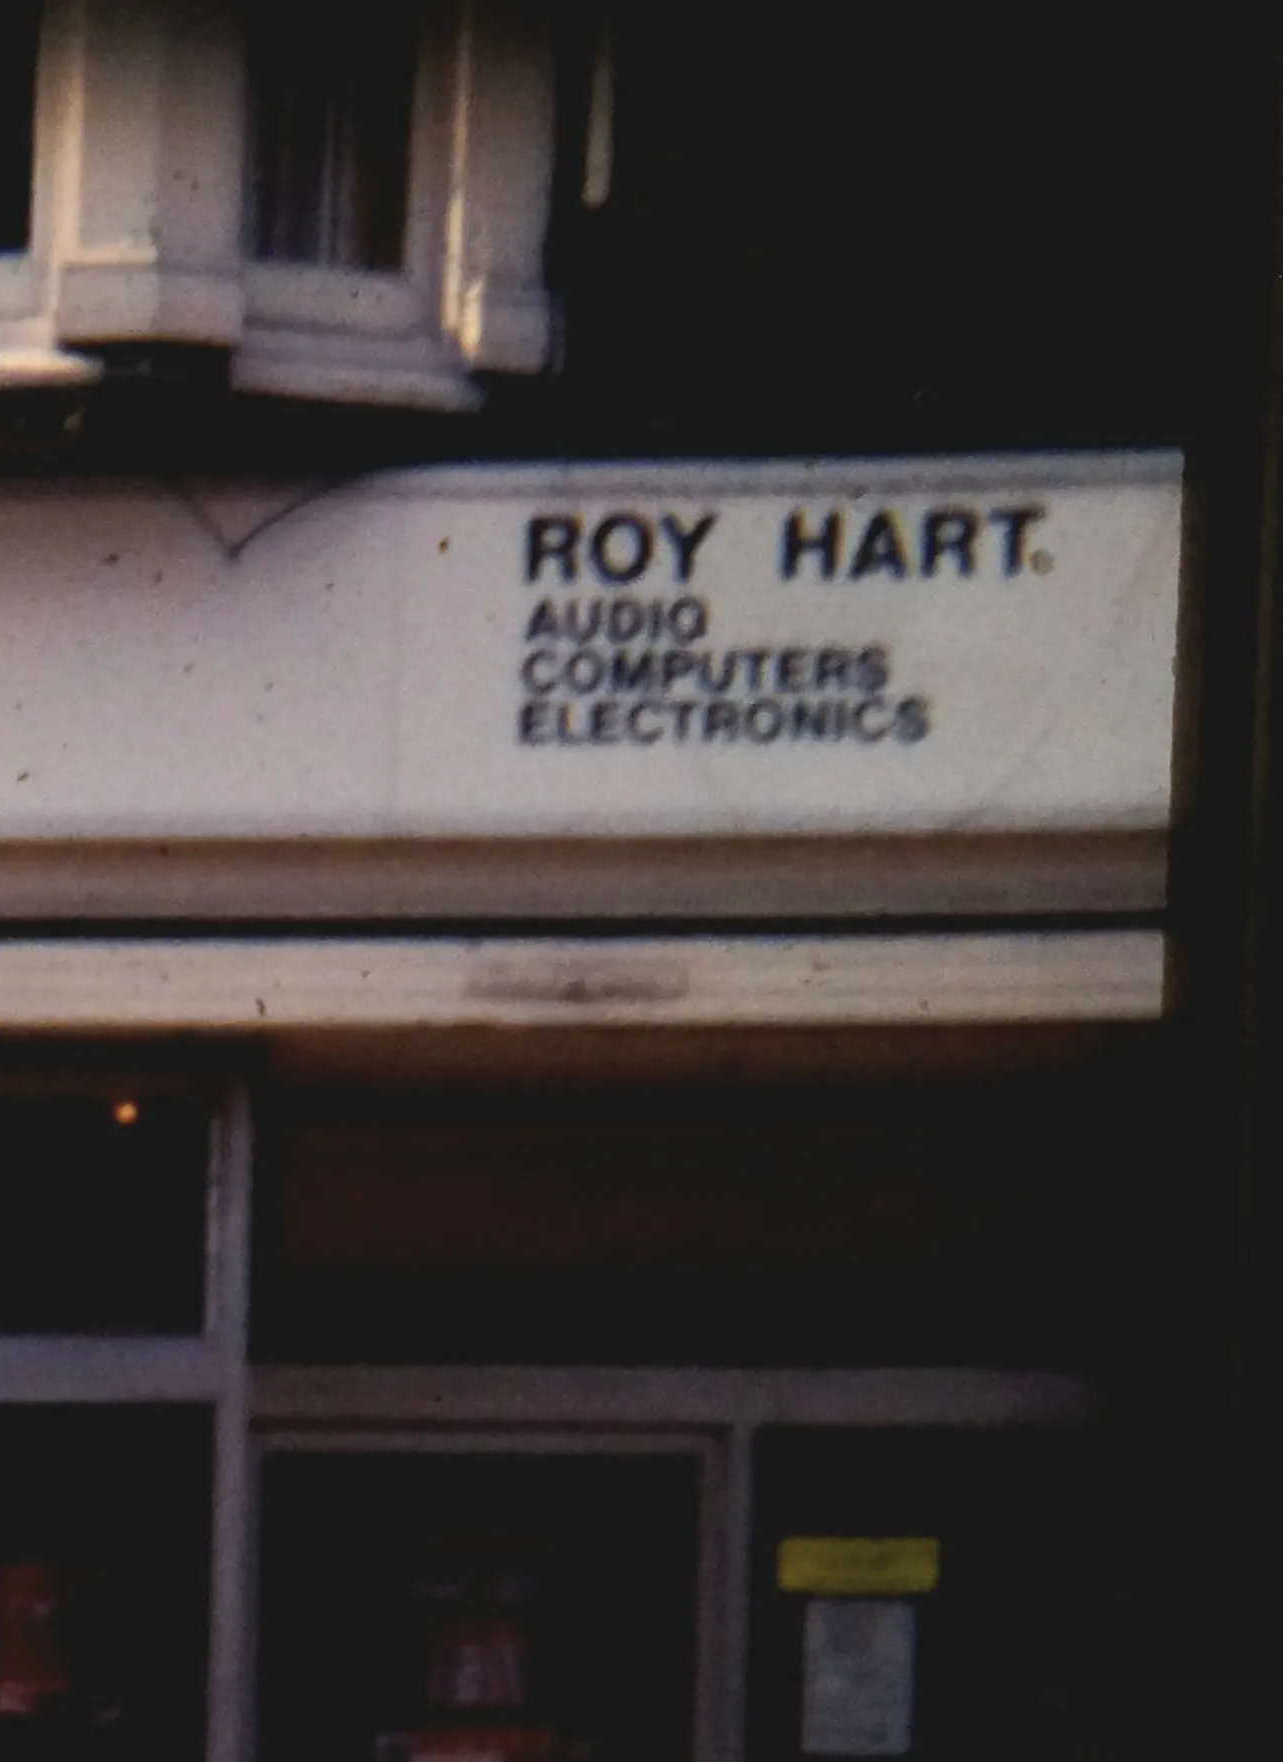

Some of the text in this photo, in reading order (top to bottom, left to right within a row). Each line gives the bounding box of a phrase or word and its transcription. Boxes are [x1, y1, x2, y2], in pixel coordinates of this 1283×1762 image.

[523, 505, 1045, 584] ROY HART
[526, 595, 709, 644] AUDIO
[520, 645, 892, 697] COMPUTERS
[518, 699, 932, 746] ELECTRONICS
